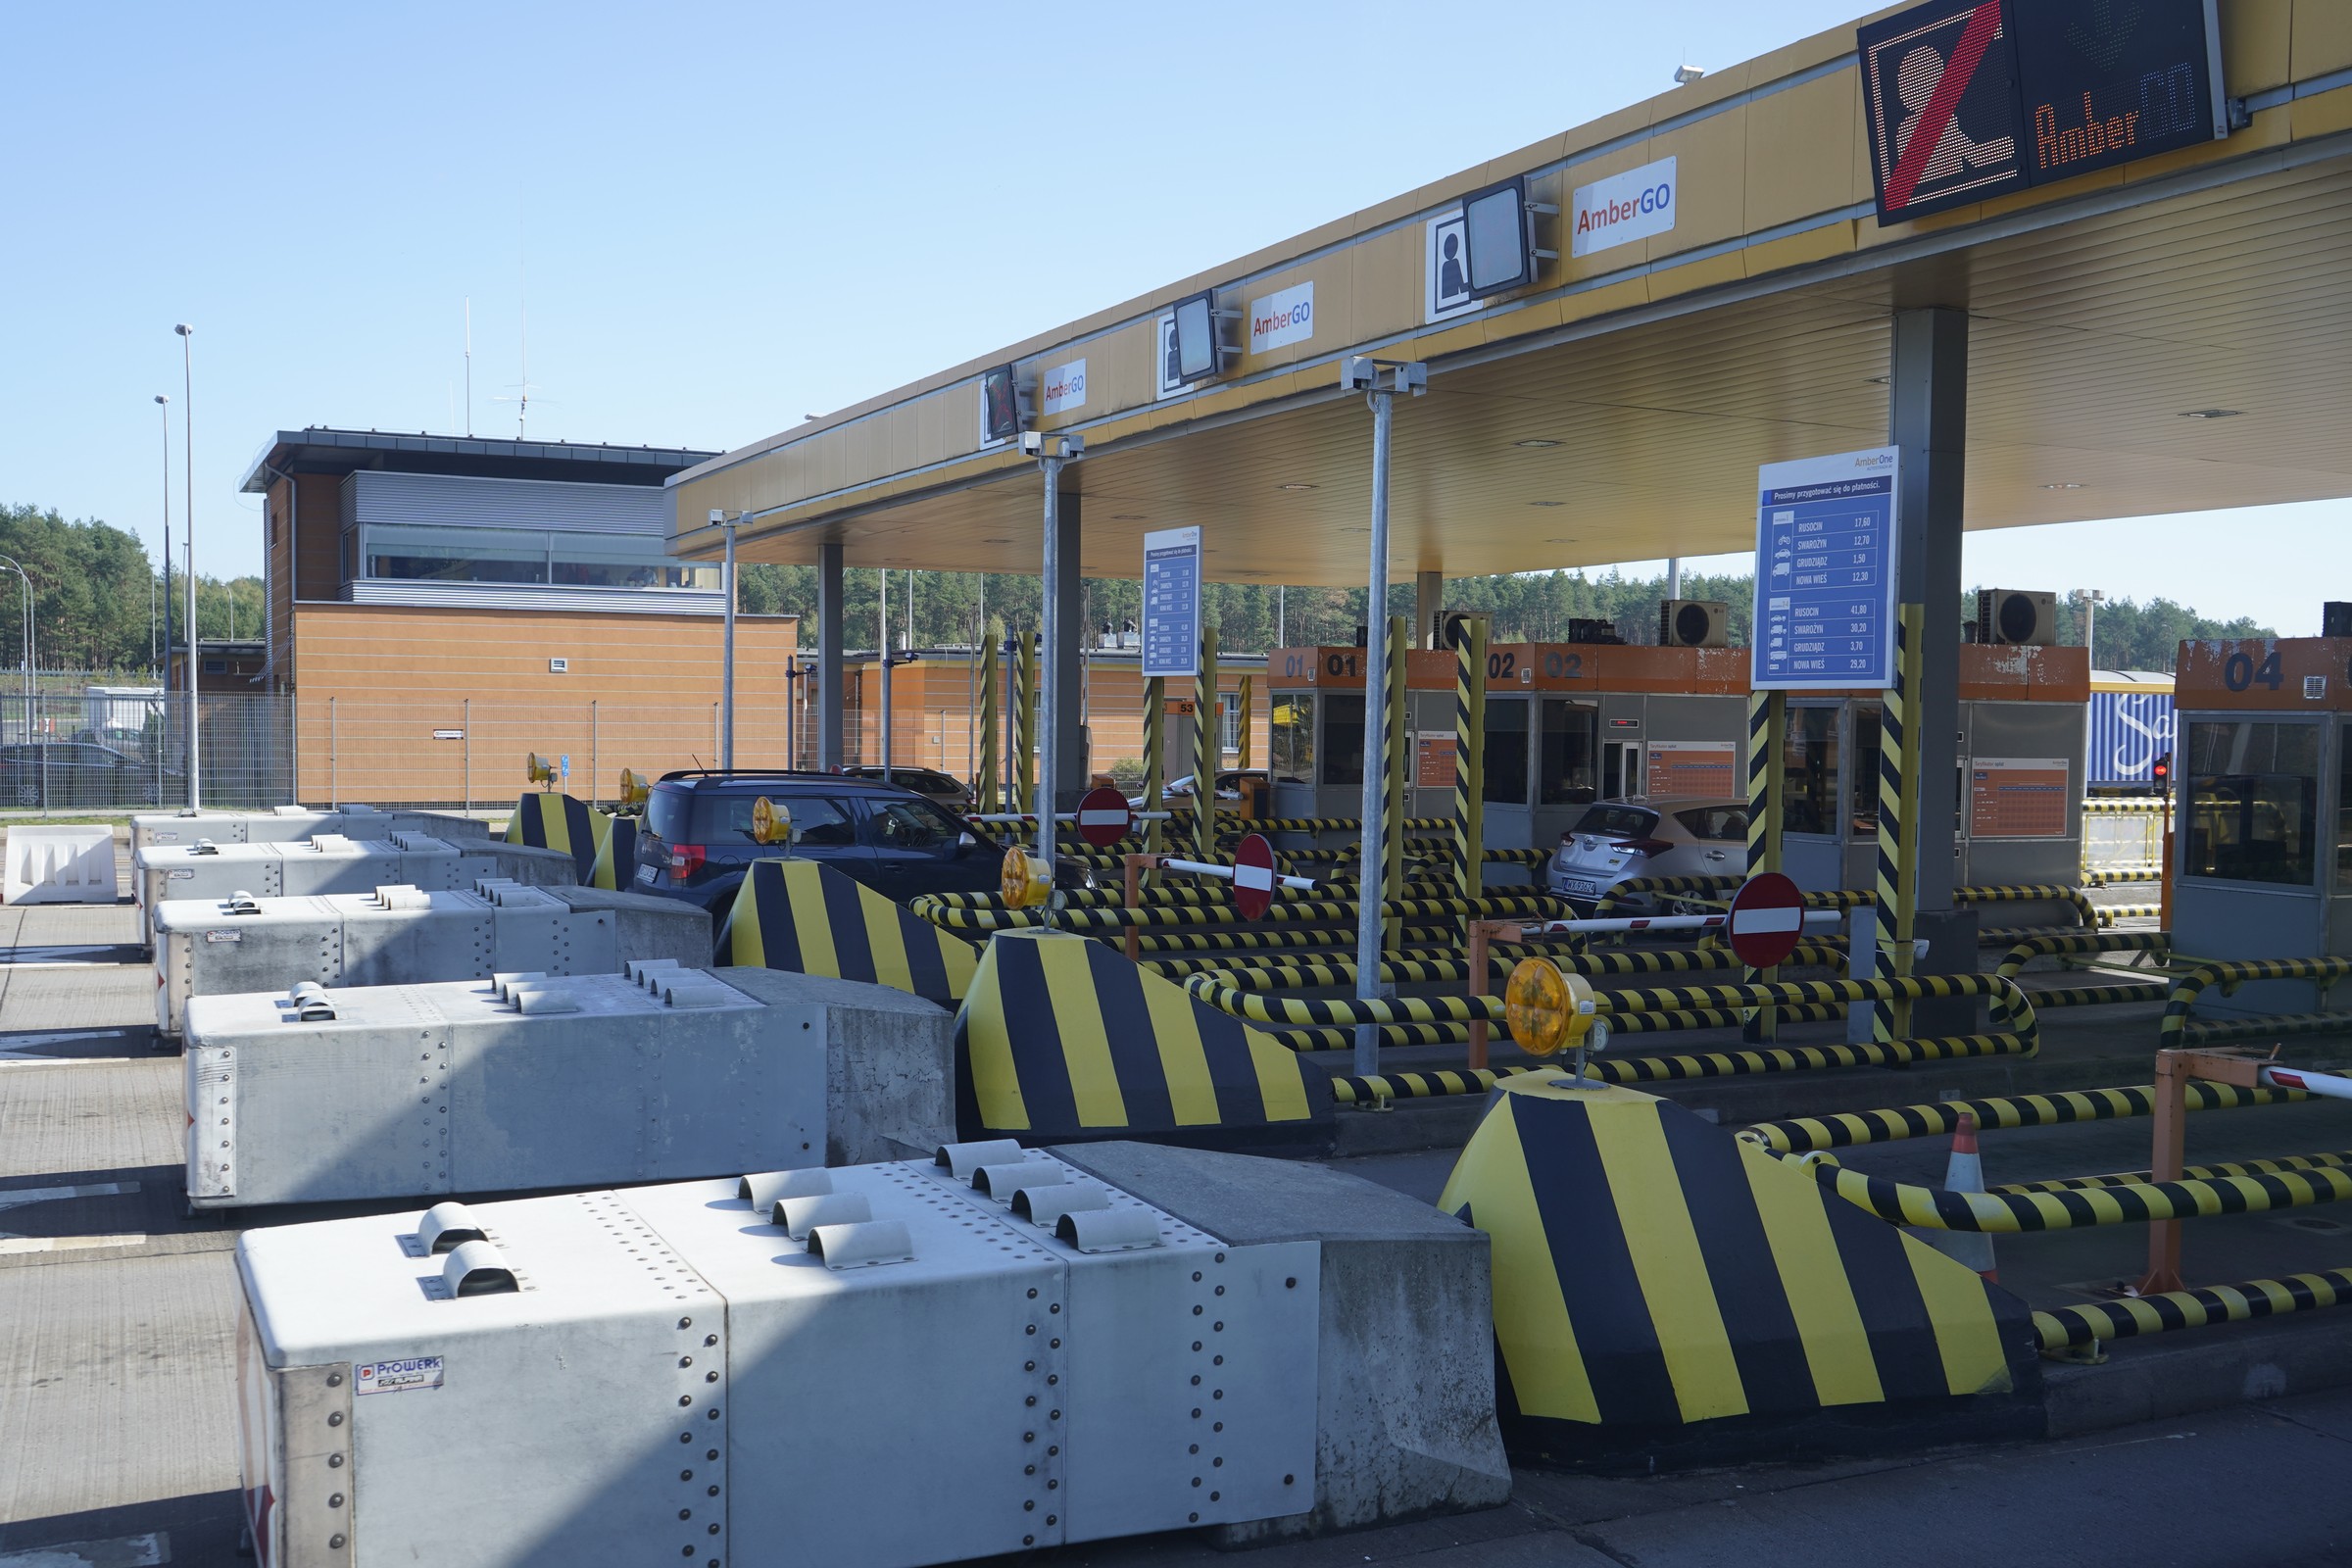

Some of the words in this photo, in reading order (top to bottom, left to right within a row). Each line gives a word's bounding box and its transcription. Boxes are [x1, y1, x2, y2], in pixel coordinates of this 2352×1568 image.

[1577, 183, 1671, 235] AmberGO
[1252, 301, 1310, 337] AmberGO
[1046, 374, 1084, 402] AmberGO
[1855, 455, 1893, 467] AmberOne
[1796, 488, 1832, 498] przygotować
[1851, 480, 1881, 491] płatności.
[1798, 521, 1823, 533] RUSOCIN
[1854, 517, 1871, 528] 17,60
[1797, 537, 1827, 550] SWAROŻYN
[1854, 535, 1870, 546] 12,70
[1796, 557, 1828, 567] GRUDZIĄDZ
[1853, 554, 1866, 564] 1,50
[1795, 575, 1812, 585] NOWA
[1813, 572, 1828, 584] WIEŚ
[1852, 571, 1869, 582] 12,30
[1794, 607, 1819, 617] RUSOCIN
[1850, 605, 1867, 614] 41,80
[1794, 623, 1823, 635] SWAROŻYN
[1850, 622, 1867, 633] 30,20
[1793, 642, 1825, 653] GRUDZIĄDZ
[1850, 641, 1863, 652] 3,70
[1285, 655, 1303, 678] 01
[1327, 654, 1356, 677] 01
[1488, 652, 1515, 679] 02
[1544, 652, 1583, 678] 02
[1793, 660, 1810, 669] NOWA
[1810, 658, 1825, 669] WIEŚ
[1849, 659, 1866, 669] 29,20
[2224, 652, 2284, 692] 04
[1180, 704, 1194, 712] 53
